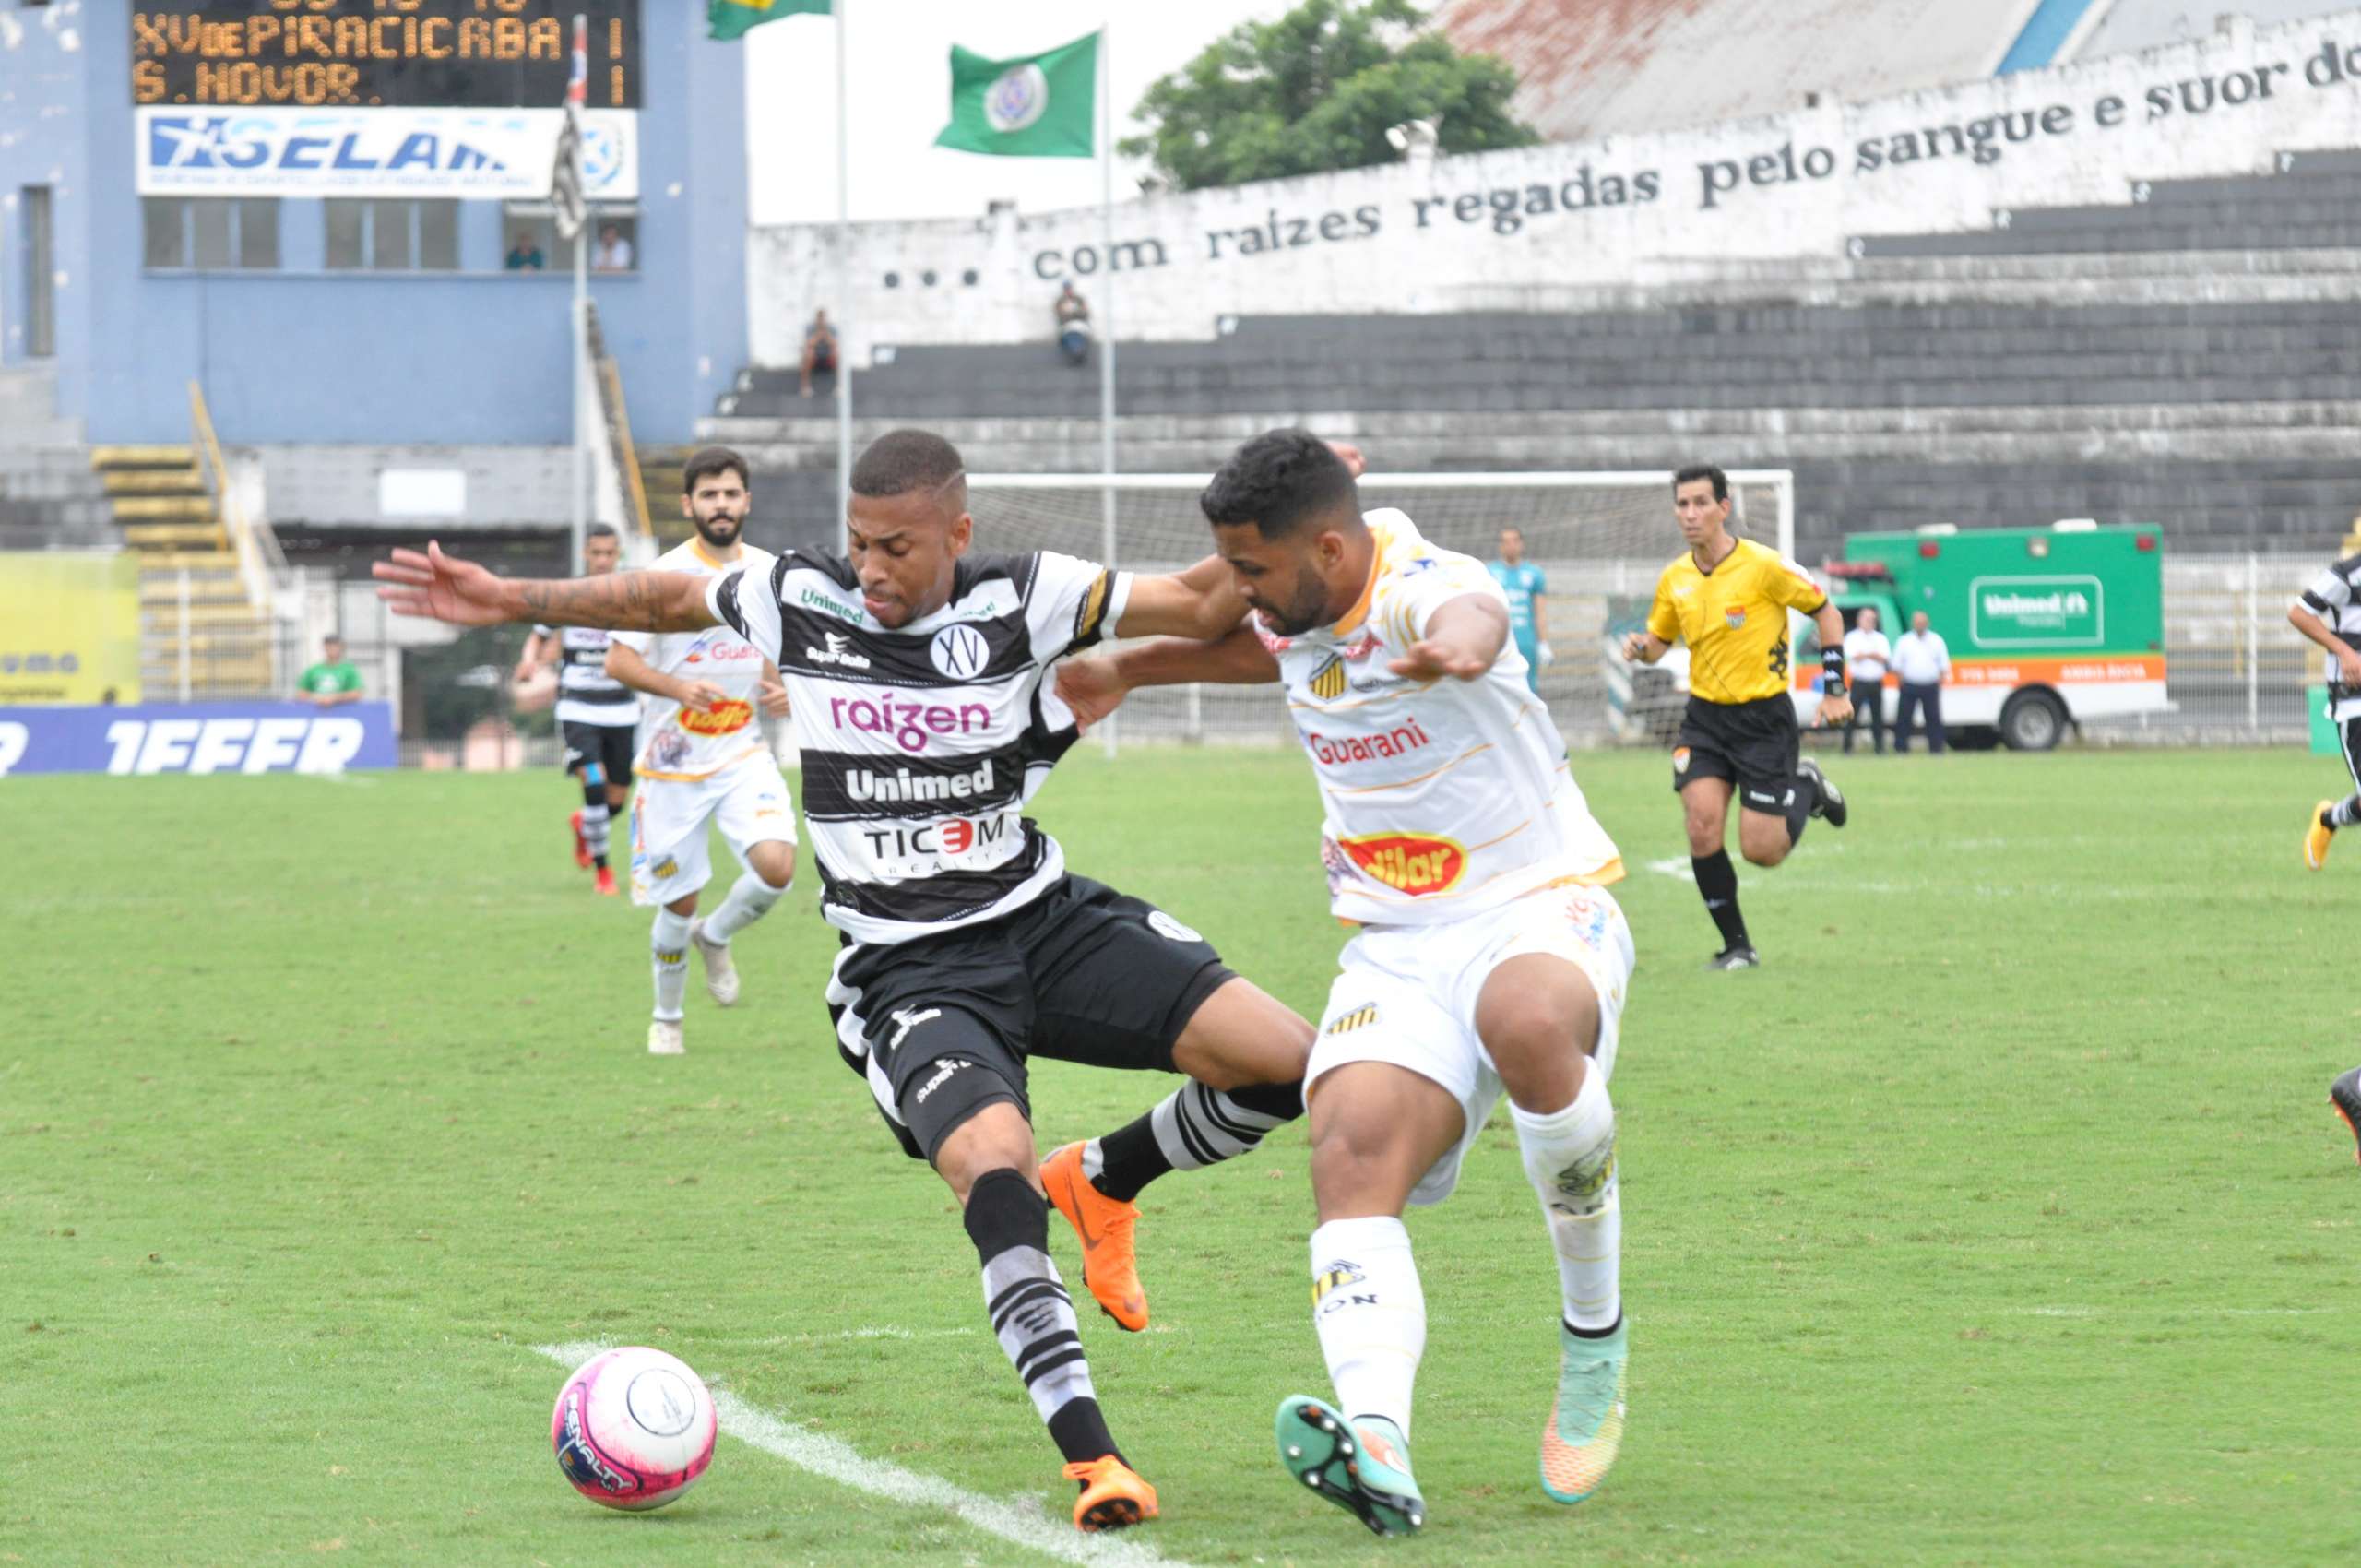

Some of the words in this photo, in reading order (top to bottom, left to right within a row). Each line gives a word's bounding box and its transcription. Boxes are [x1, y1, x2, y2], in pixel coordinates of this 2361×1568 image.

[1033, 239, 1167, 280] com
[1412, 165, 1660, 235] regadas
[1697, 141, 1835, 208] pelo
[1855, 104, 2074, 172] sangue
[2094, 95, 2125, 128] e
[2144, 62, 2289, 122] suor
[801, 589, 864, 624] Unimed
[939, 628, 978, 676] XV
[1310, 716, 1429, 765] Guarani
[846, 758, 994, 801] Unimed
